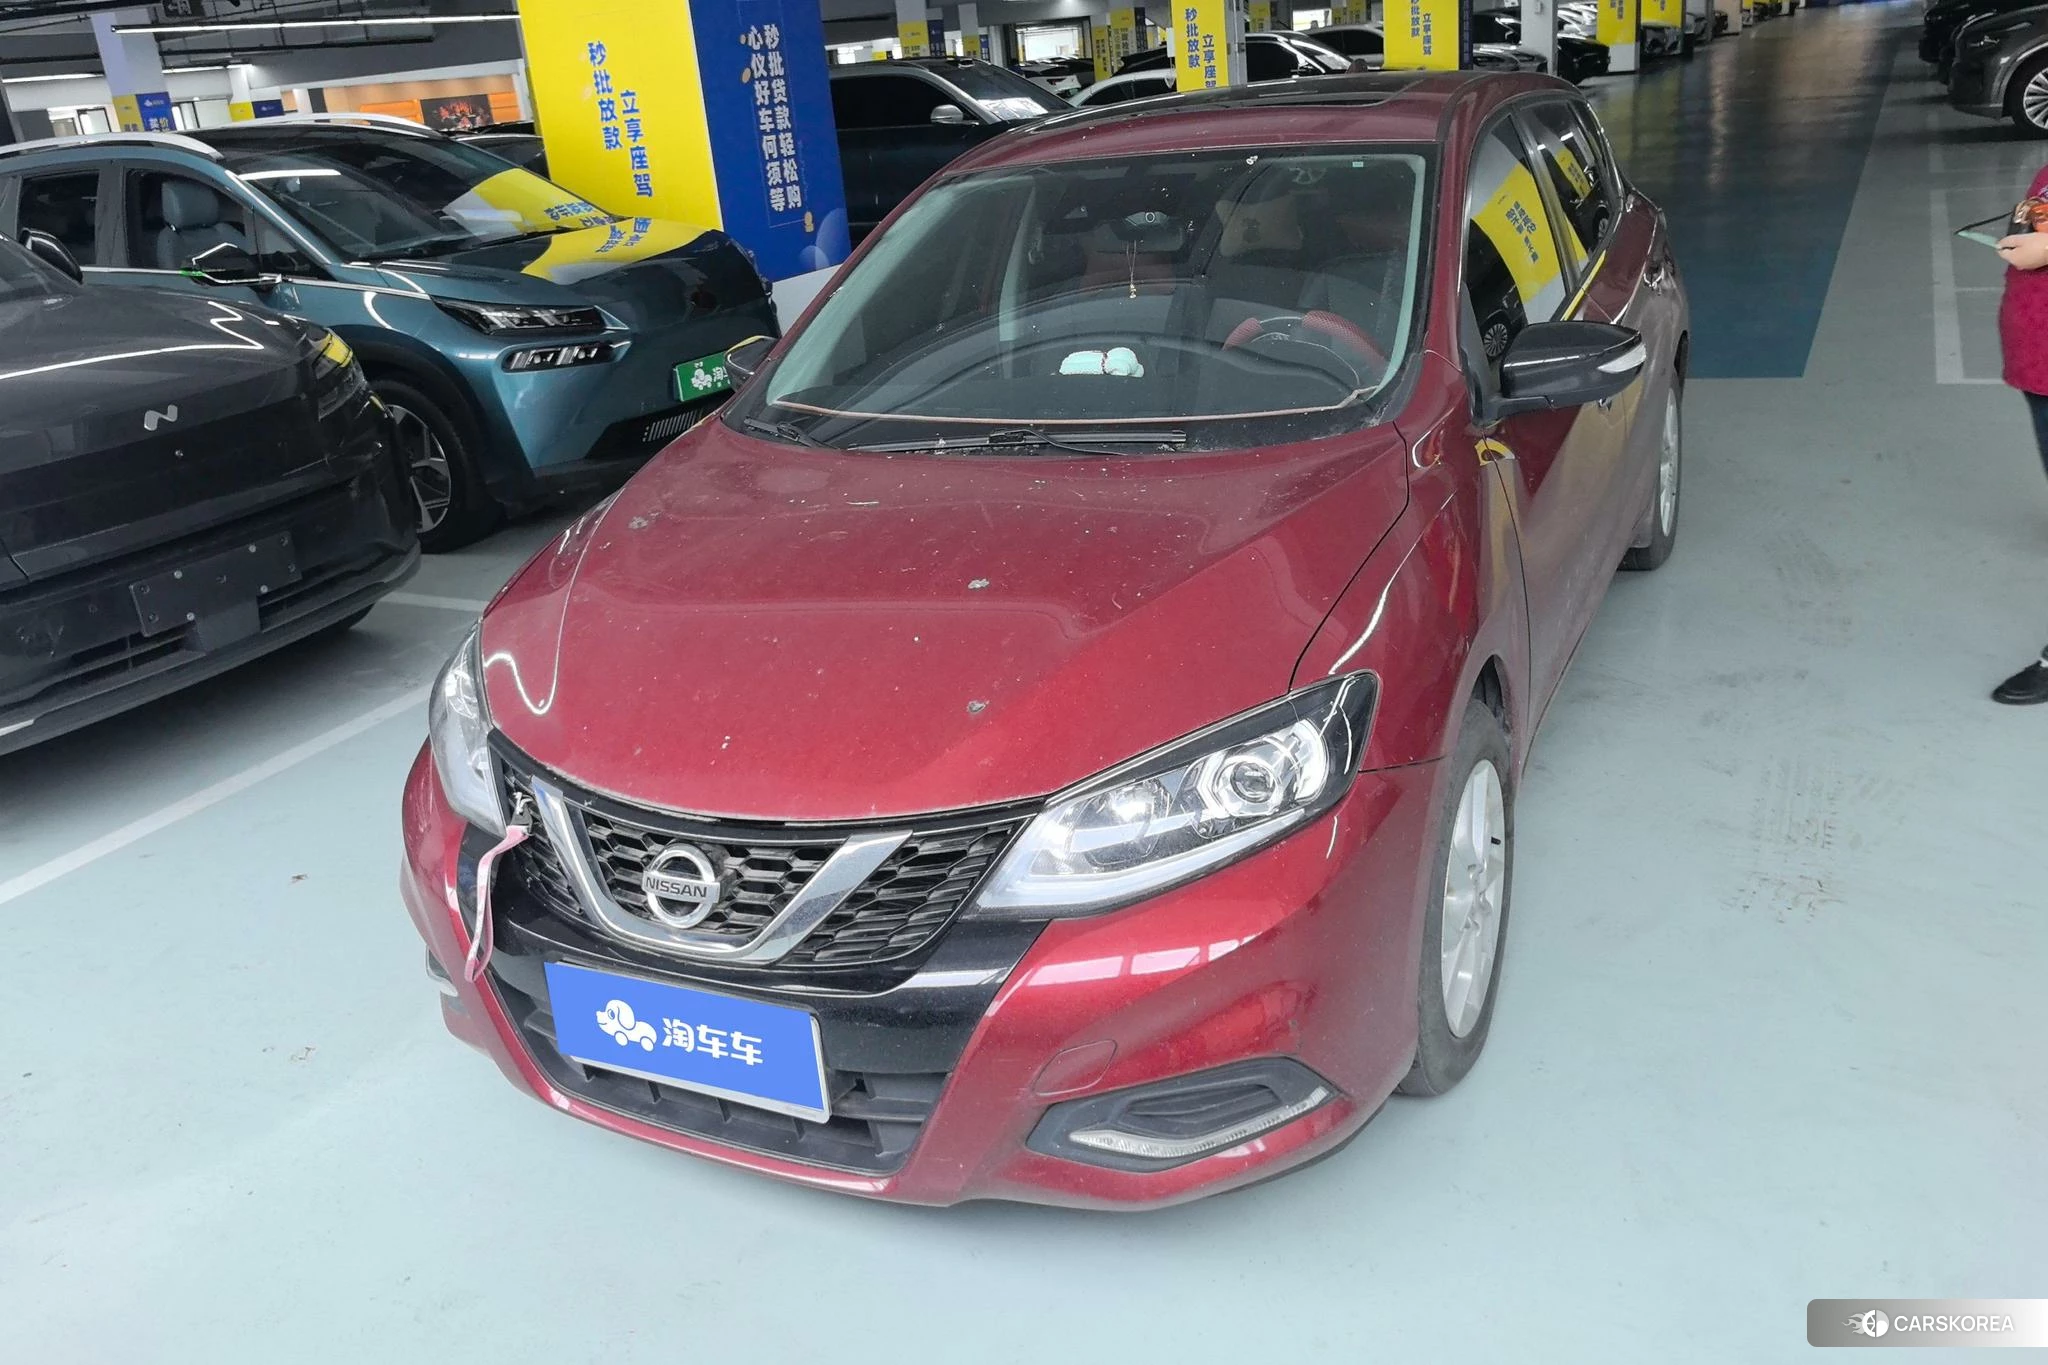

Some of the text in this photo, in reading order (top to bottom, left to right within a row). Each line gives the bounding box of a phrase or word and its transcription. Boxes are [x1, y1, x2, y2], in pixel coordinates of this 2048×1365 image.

[1185, 8, 1200, 68] 秒批放款
[588, 41, 623, 150] 秒批放款
[620, 90, 653, 198] 立享座驾
[747, 25, 786, 213] 心仪好车何须等
[763, 24, 802, 209] 秒批贷款轻松购
[645, 876, 708, 898] NISSAN
